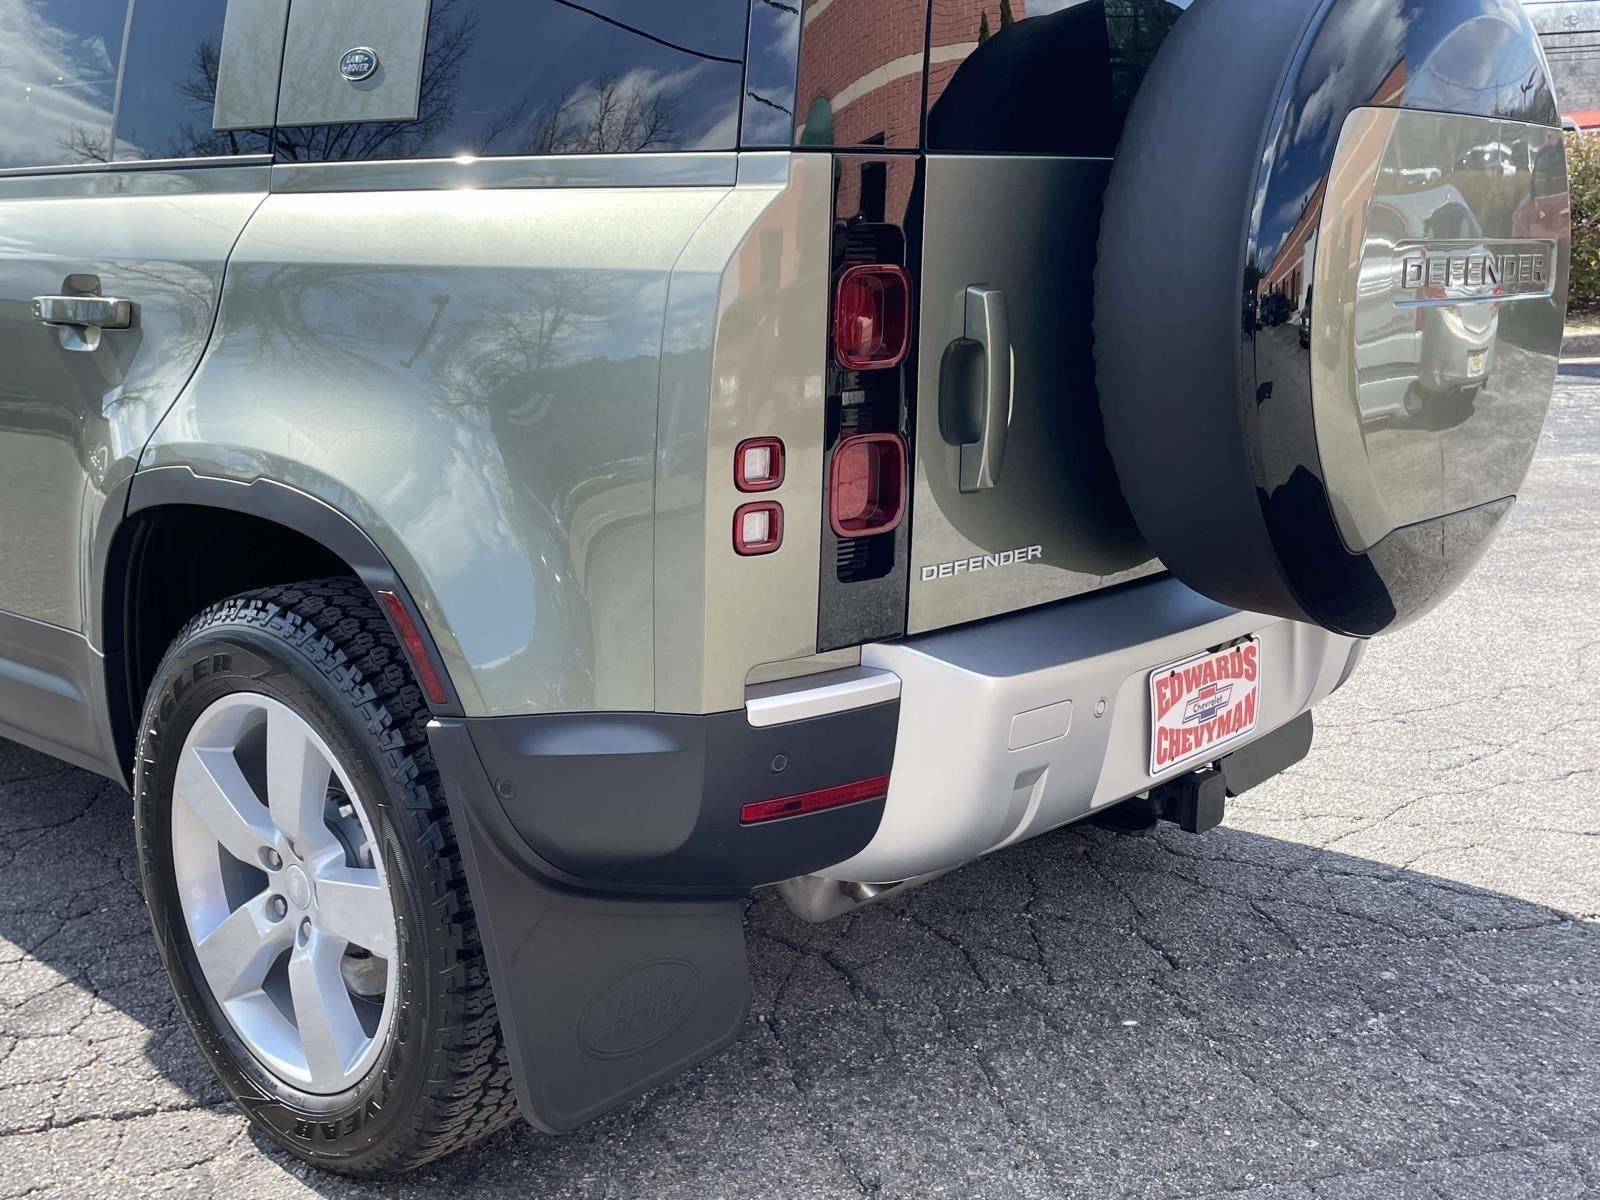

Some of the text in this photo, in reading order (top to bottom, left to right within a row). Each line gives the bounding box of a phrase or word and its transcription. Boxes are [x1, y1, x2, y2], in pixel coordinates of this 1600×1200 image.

[348, 63, 369, 72] ROVER
[1402, 254, 1546, 288] DEFENDER
[920, 544, 1043, 582] DEFENDER
[1155, 645, 1257, 722] EDWARDS
[1193, 695, 1223, 713] Chevrolet
[1156, 686, 1257, 765] CHEVYMAN
